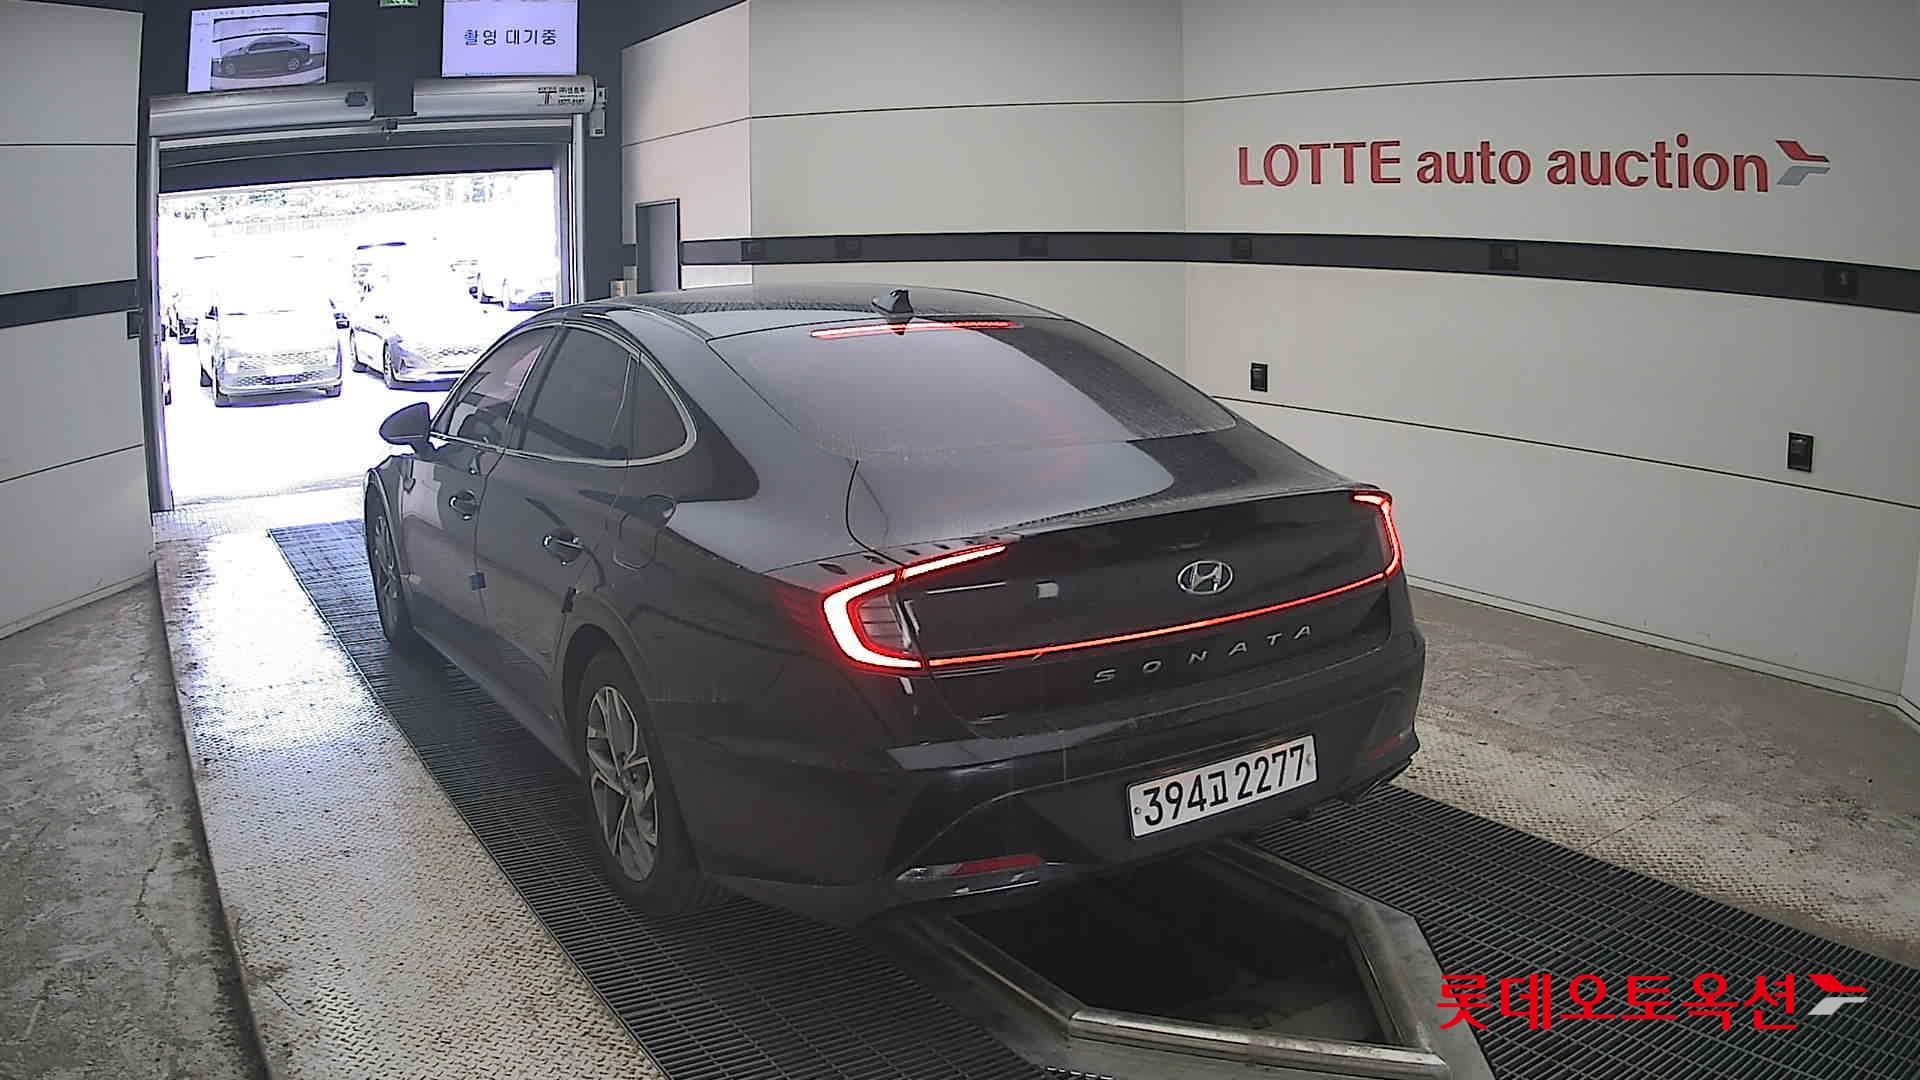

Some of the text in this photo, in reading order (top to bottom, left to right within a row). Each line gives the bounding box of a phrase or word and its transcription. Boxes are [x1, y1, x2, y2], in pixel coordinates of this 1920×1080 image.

[505, 29, 557, 46] 대기중
[1239, 134, 1769, 192] LOTTE auto auction
[1094, 625, 1312, 684] SONATA
